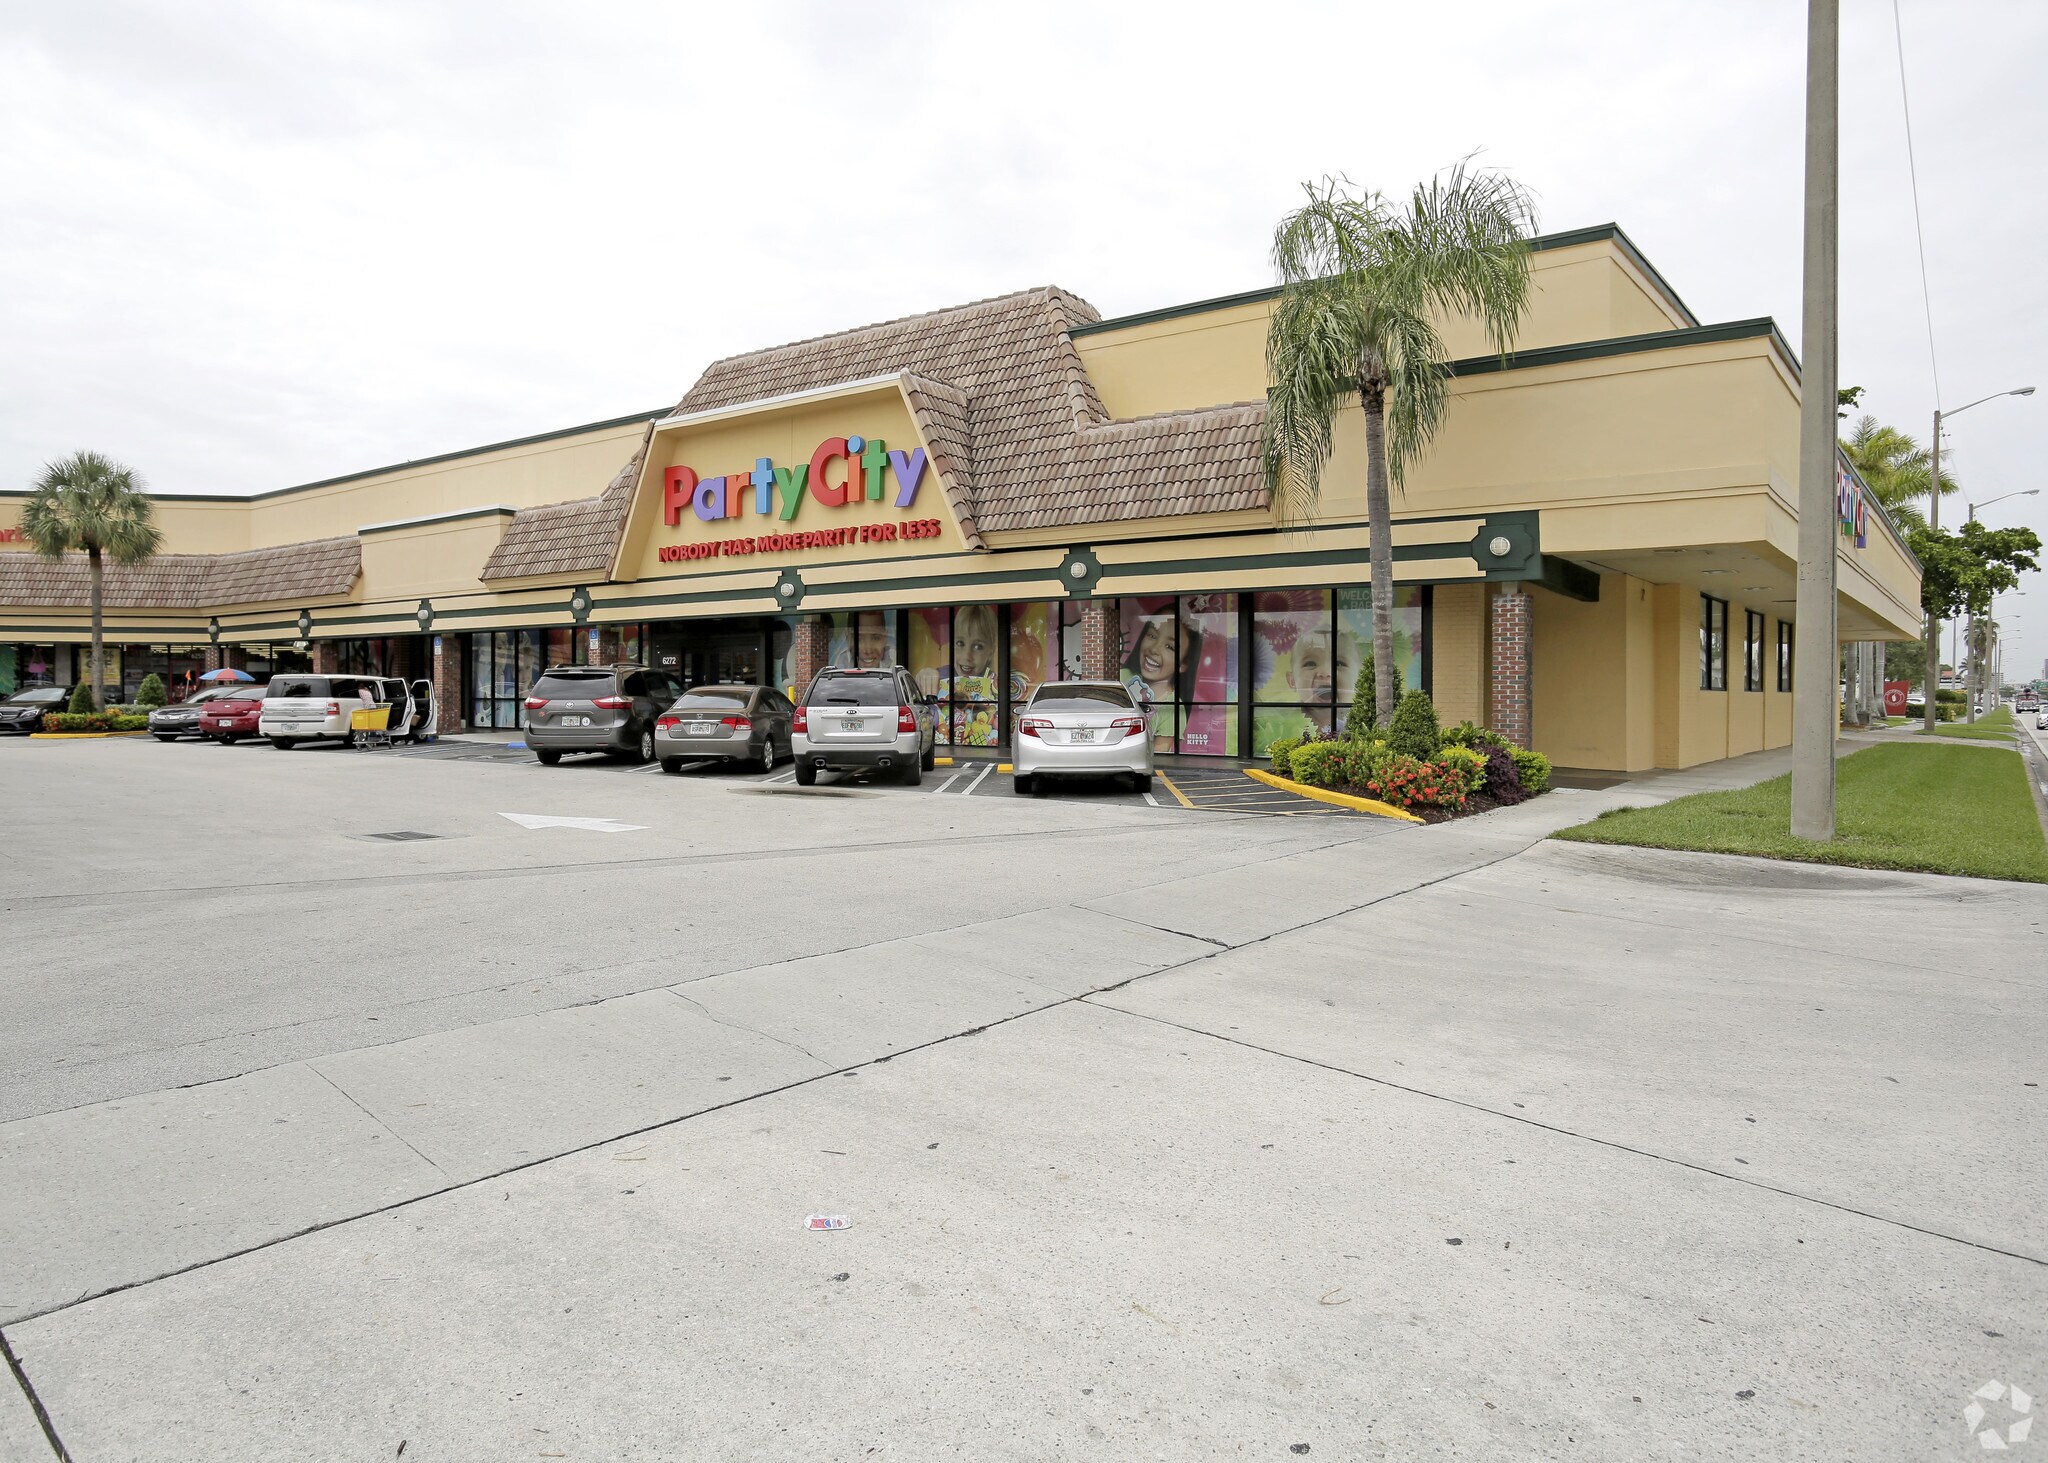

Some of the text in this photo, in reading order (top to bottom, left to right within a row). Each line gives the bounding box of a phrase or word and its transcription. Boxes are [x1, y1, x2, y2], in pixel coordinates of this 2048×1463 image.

[659, 541, 721, 562] NOBODY
[721, 537, 755, 556] HAS
[860, 523, 896, 542] FOR
[899, 519, 941, 540] LESS
[662, 657, 676, 665] 6272
